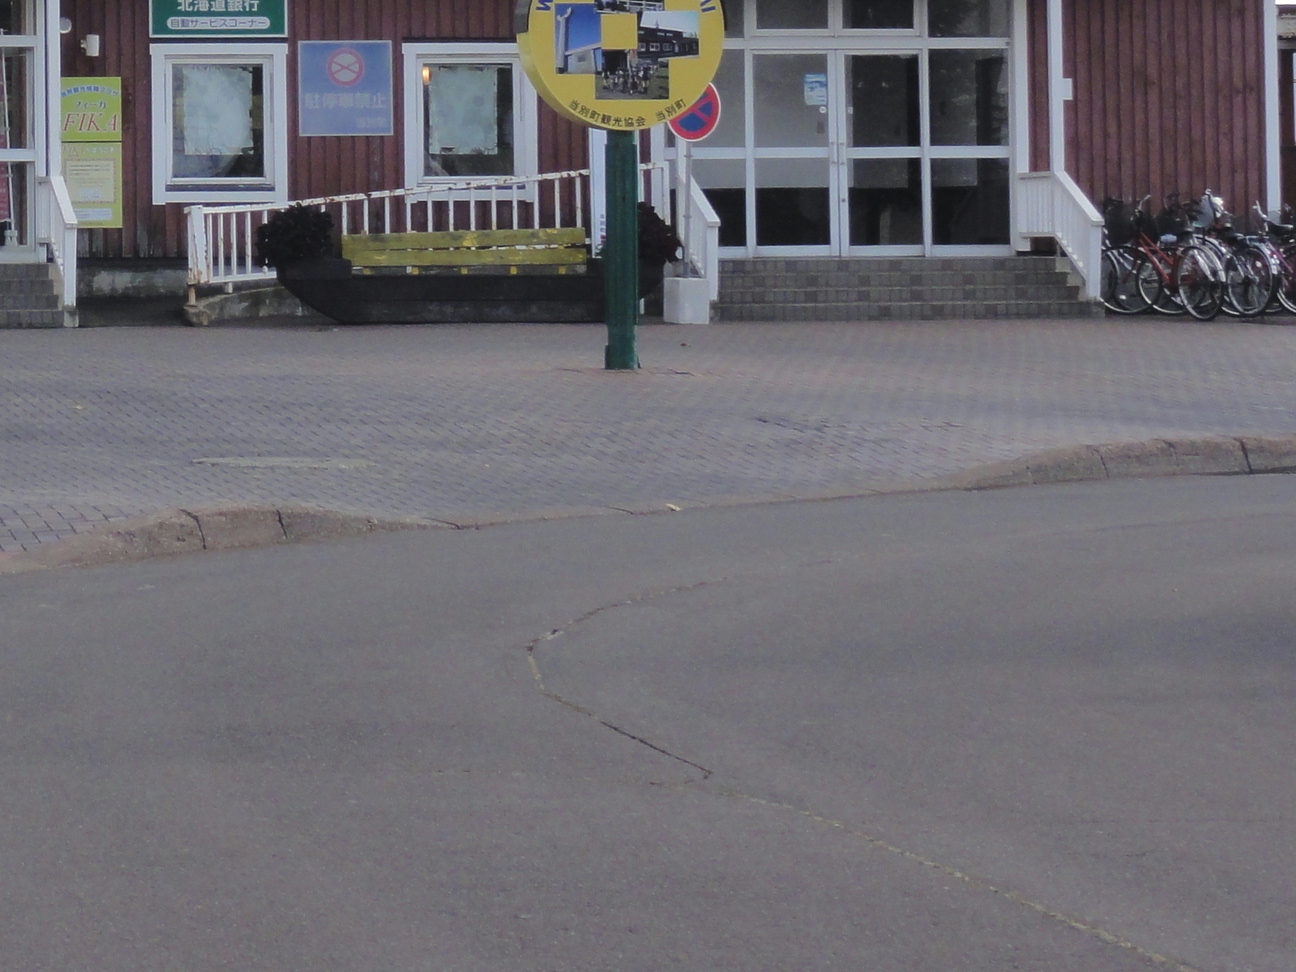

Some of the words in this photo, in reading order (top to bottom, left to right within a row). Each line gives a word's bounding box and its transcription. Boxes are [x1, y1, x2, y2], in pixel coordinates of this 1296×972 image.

[170, 18, 267, 28] 自動サービスコーナー
[76, 99, 107, 109] フィーカ
[568, 98, 646, 128] 当別町観光協会
[654, 98, 687, 122] 当別町
[62, 113, 118, 132] FIKA
